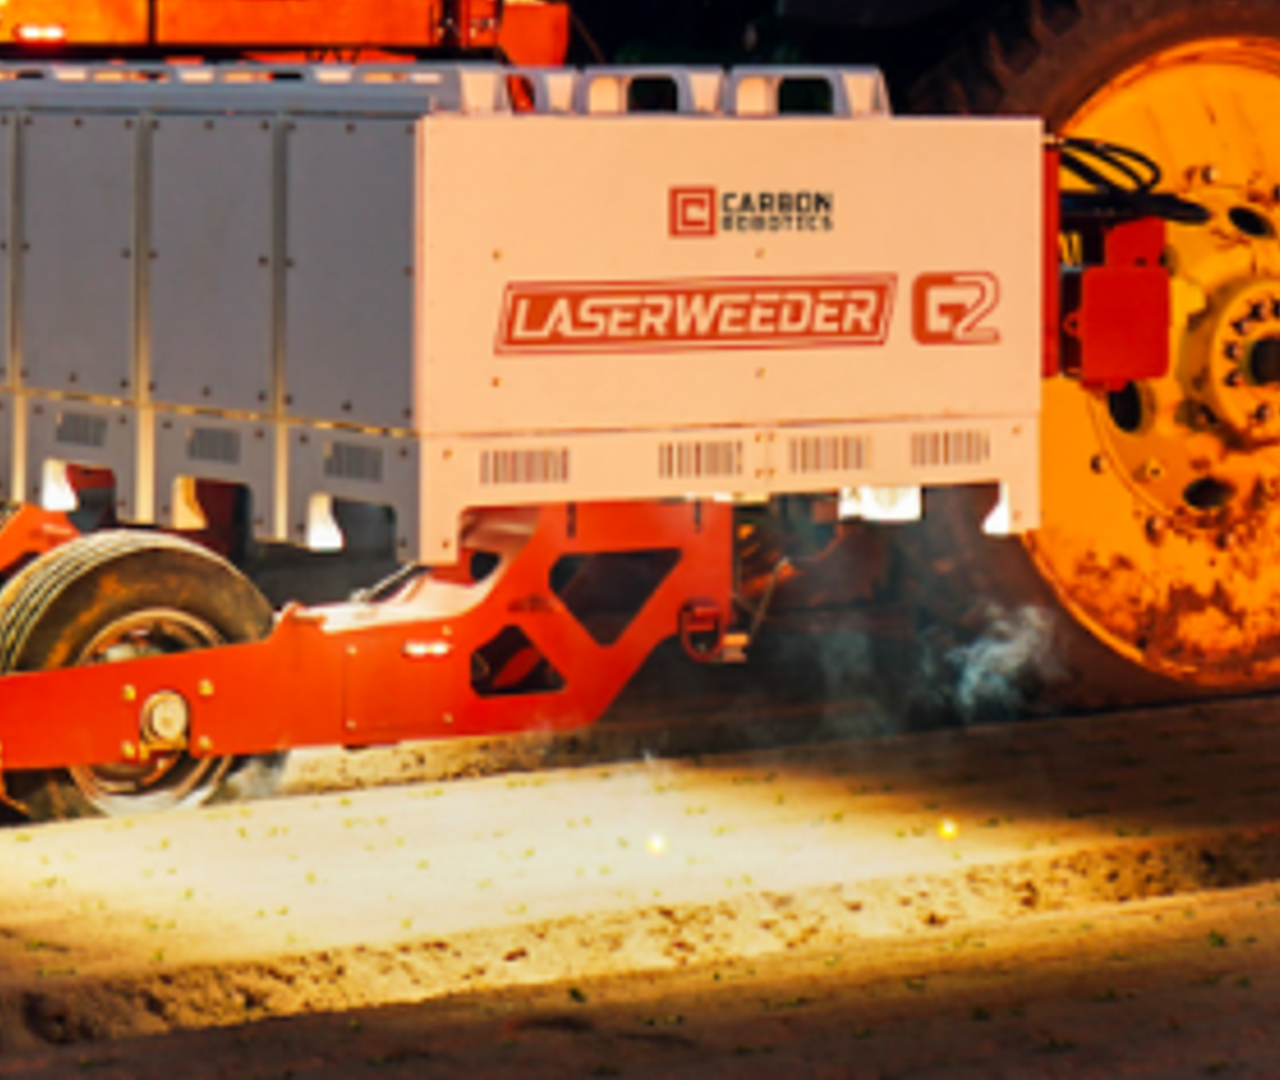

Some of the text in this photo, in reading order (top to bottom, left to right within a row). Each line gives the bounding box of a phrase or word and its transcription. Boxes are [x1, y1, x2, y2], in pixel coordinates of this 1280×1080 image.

[721, 191, 834, 214] CARBON
[721, 215, 834, 232] ROBOTICS
[511, 271, 1001, 346] LASERWEEDER G2
